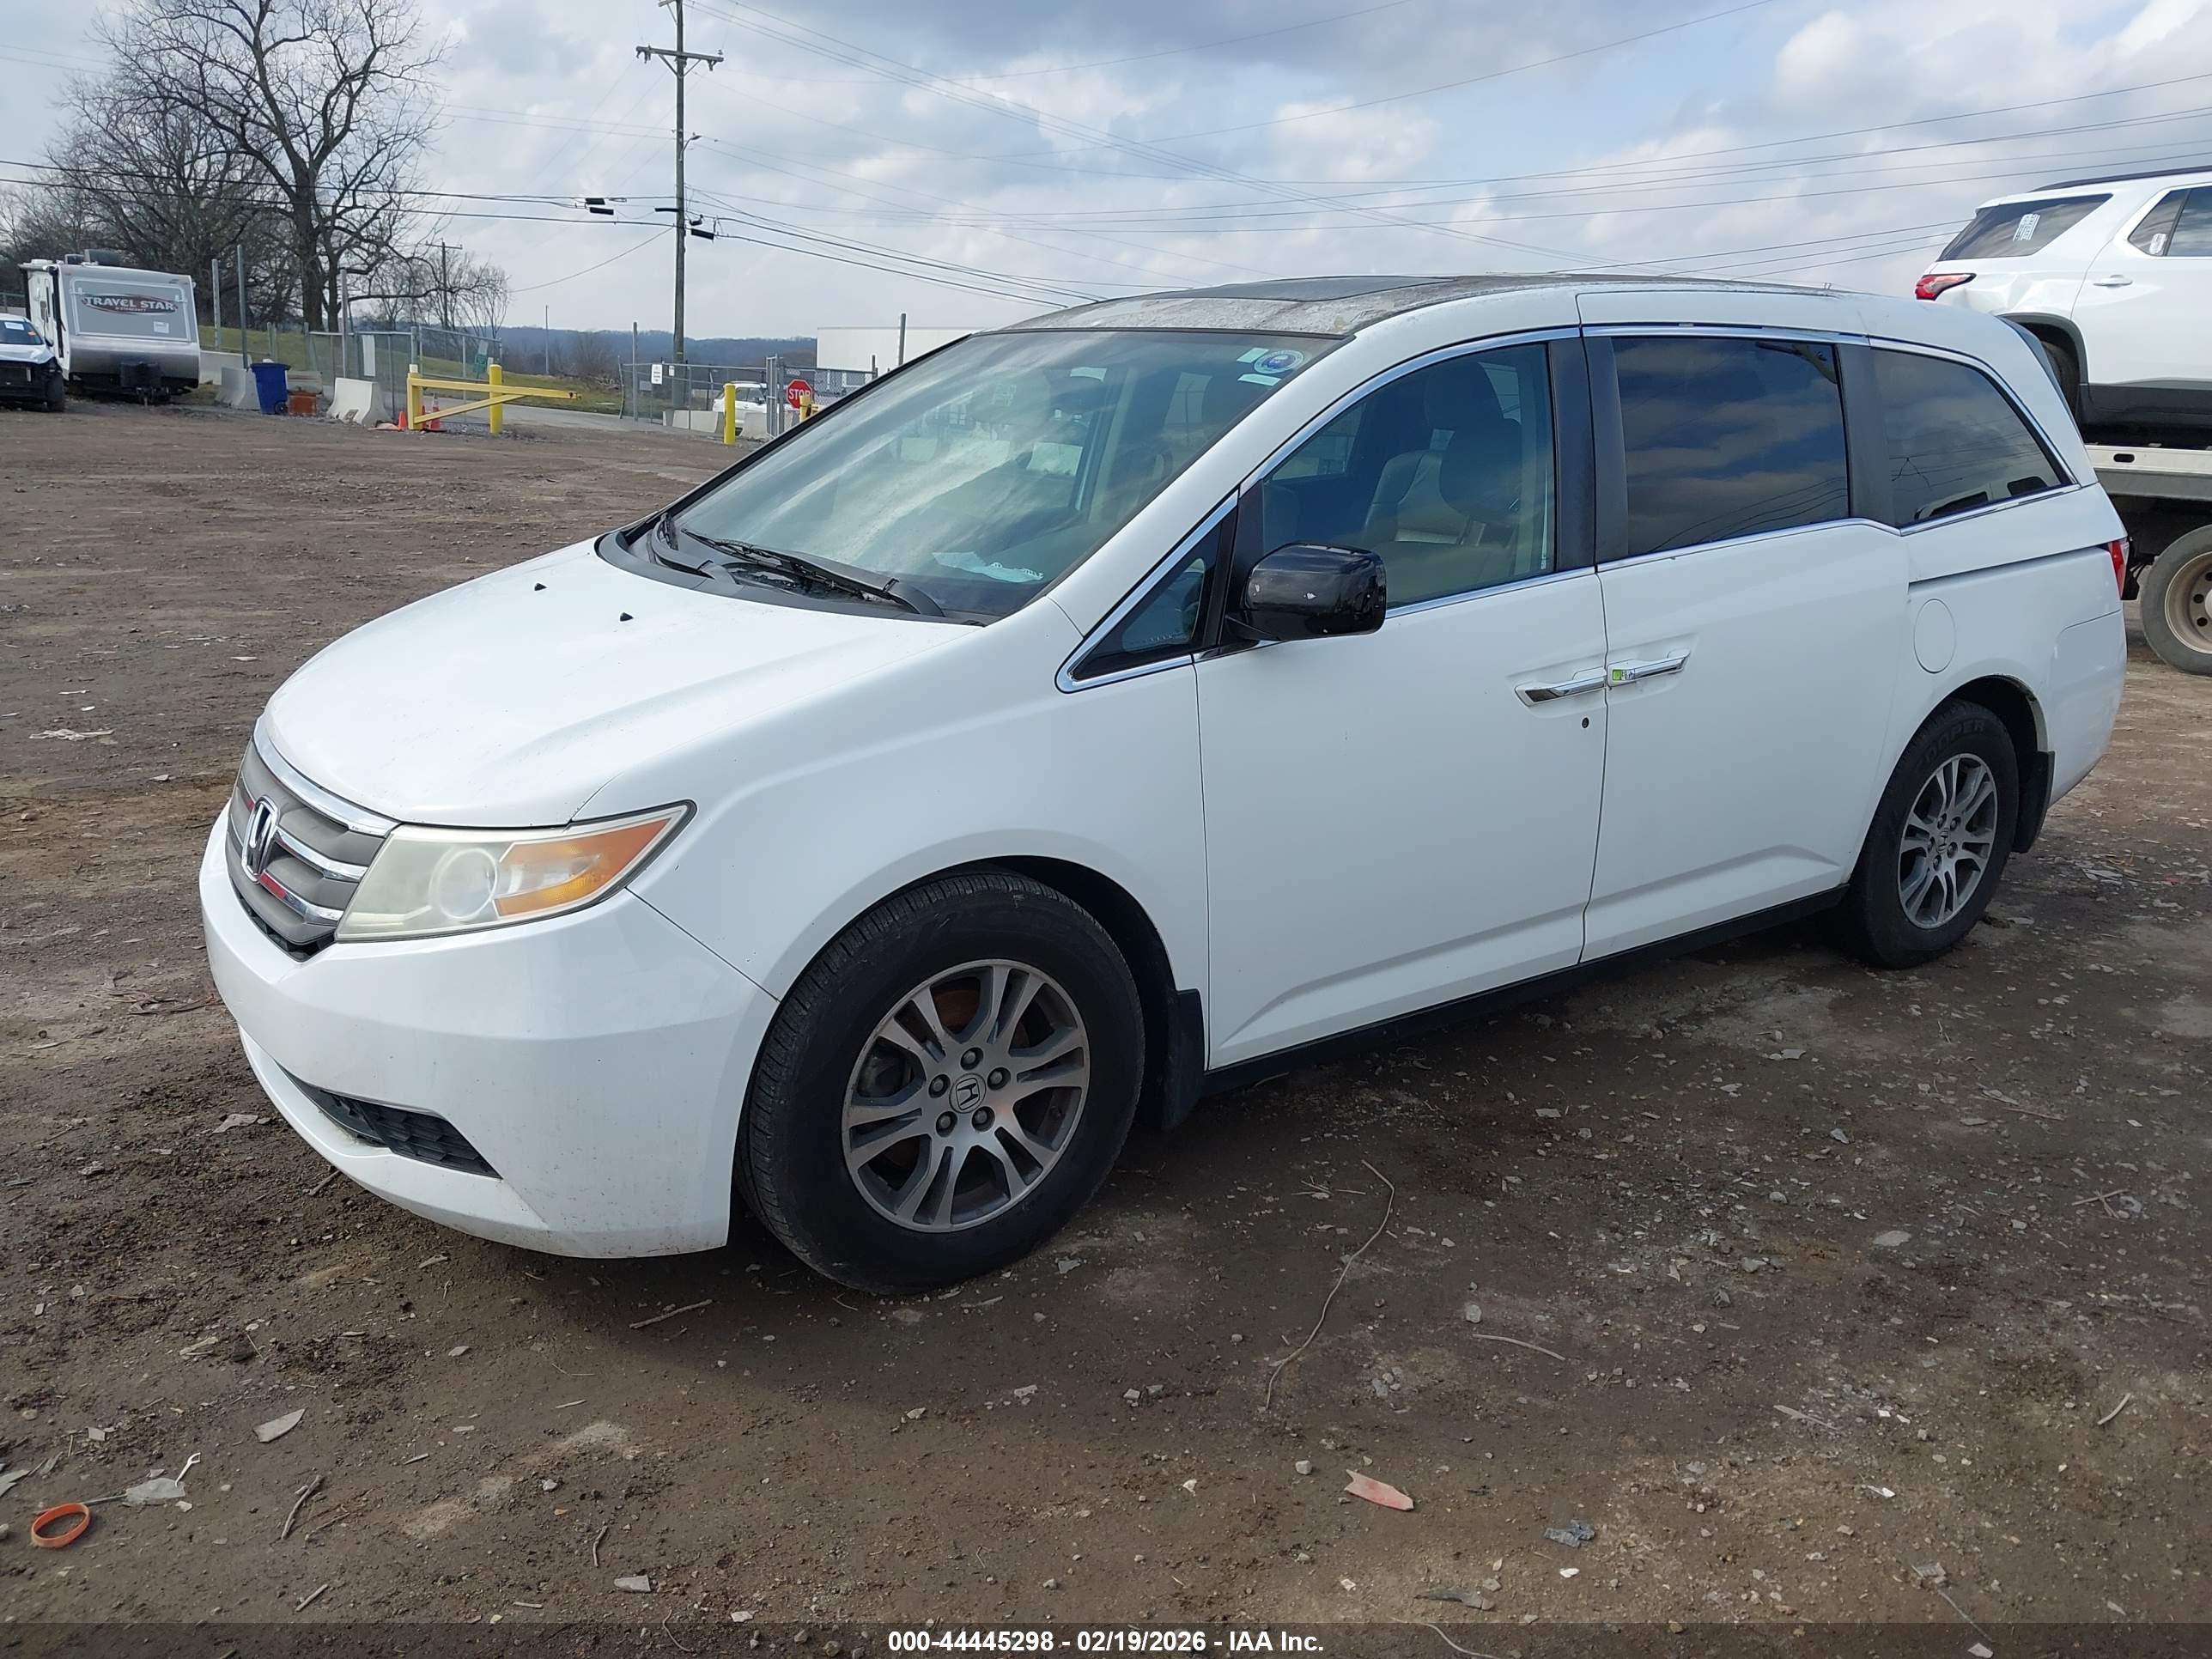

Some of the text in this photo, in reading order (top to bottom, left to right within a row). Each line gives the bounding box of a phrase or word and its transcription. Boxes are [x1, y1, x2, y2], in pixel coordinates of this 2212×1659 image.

[85, 296, 137, 308] TRAVEL
[140, 301, 174, 311] STAR
[788, 388, 811, 401] STOP
